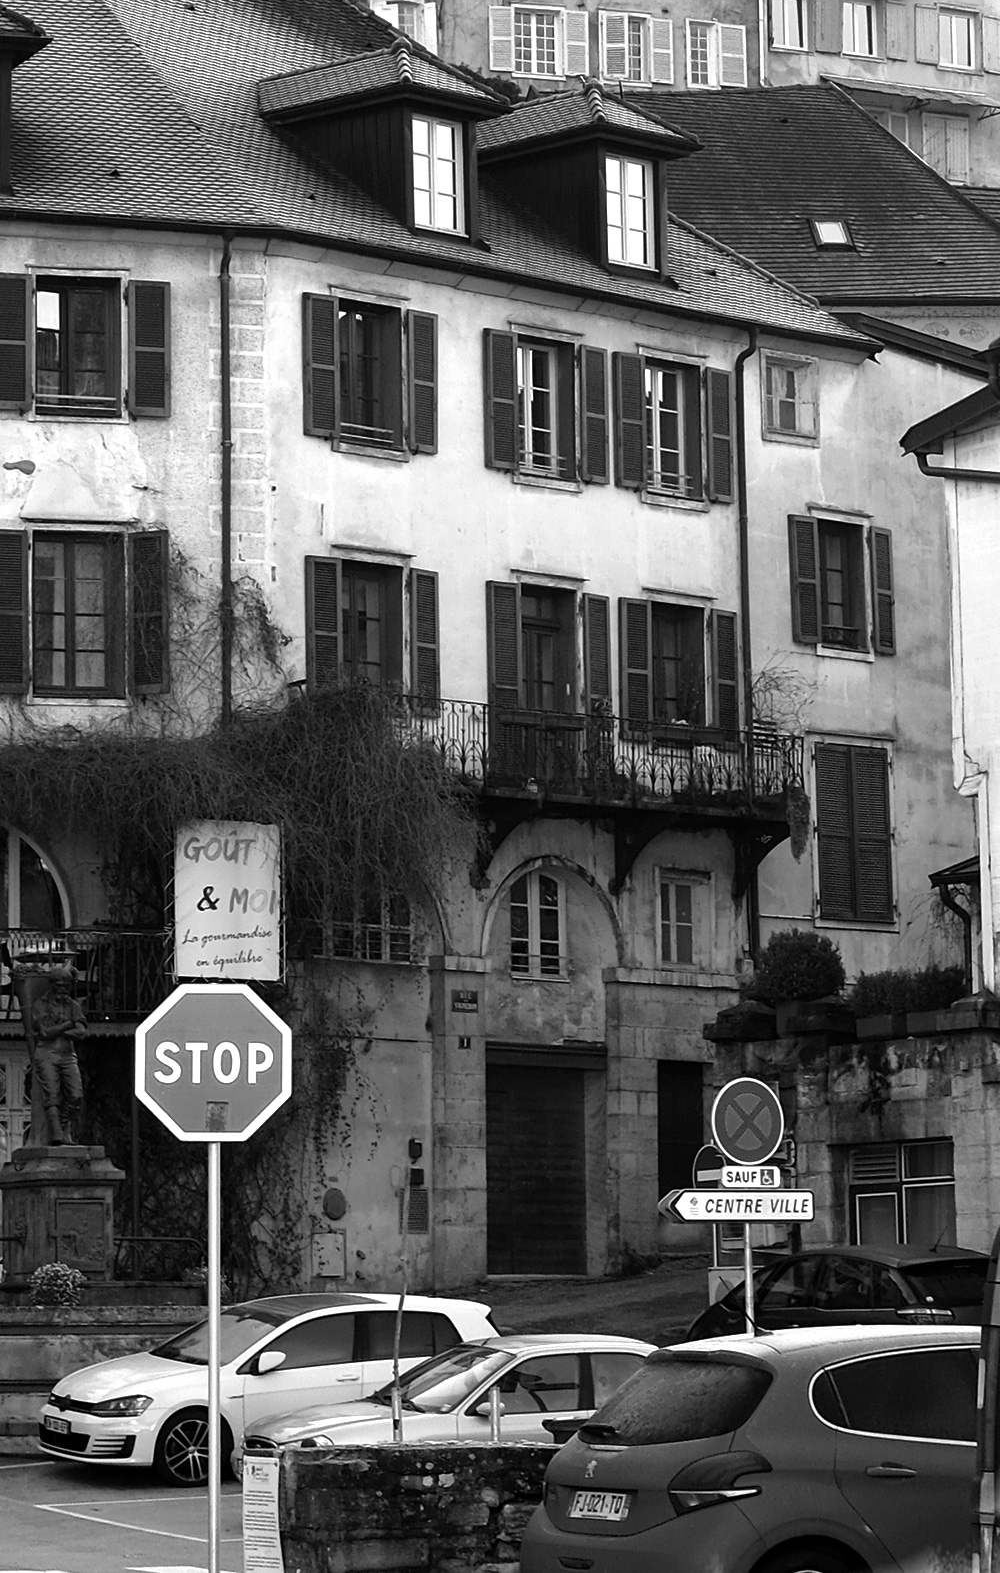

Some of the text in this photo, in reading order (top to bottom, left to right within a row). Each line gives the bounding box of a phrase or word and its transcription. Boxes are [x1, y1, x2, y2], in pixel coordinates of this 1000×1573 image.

[183, 830, 257, 866] GOÛT
[196, 885, 277, 915] & MOI
[181, 924, 273, 949] La gourmandise
[196, 949, 264, 972] en équilibre
[153, 1041, 274, 1085] STOP
[726, 1171, 758, 1183] SAUF
[704, 1198, 763, 1214] CENTRE
[770, 1198, 810, 1213] VILLE
